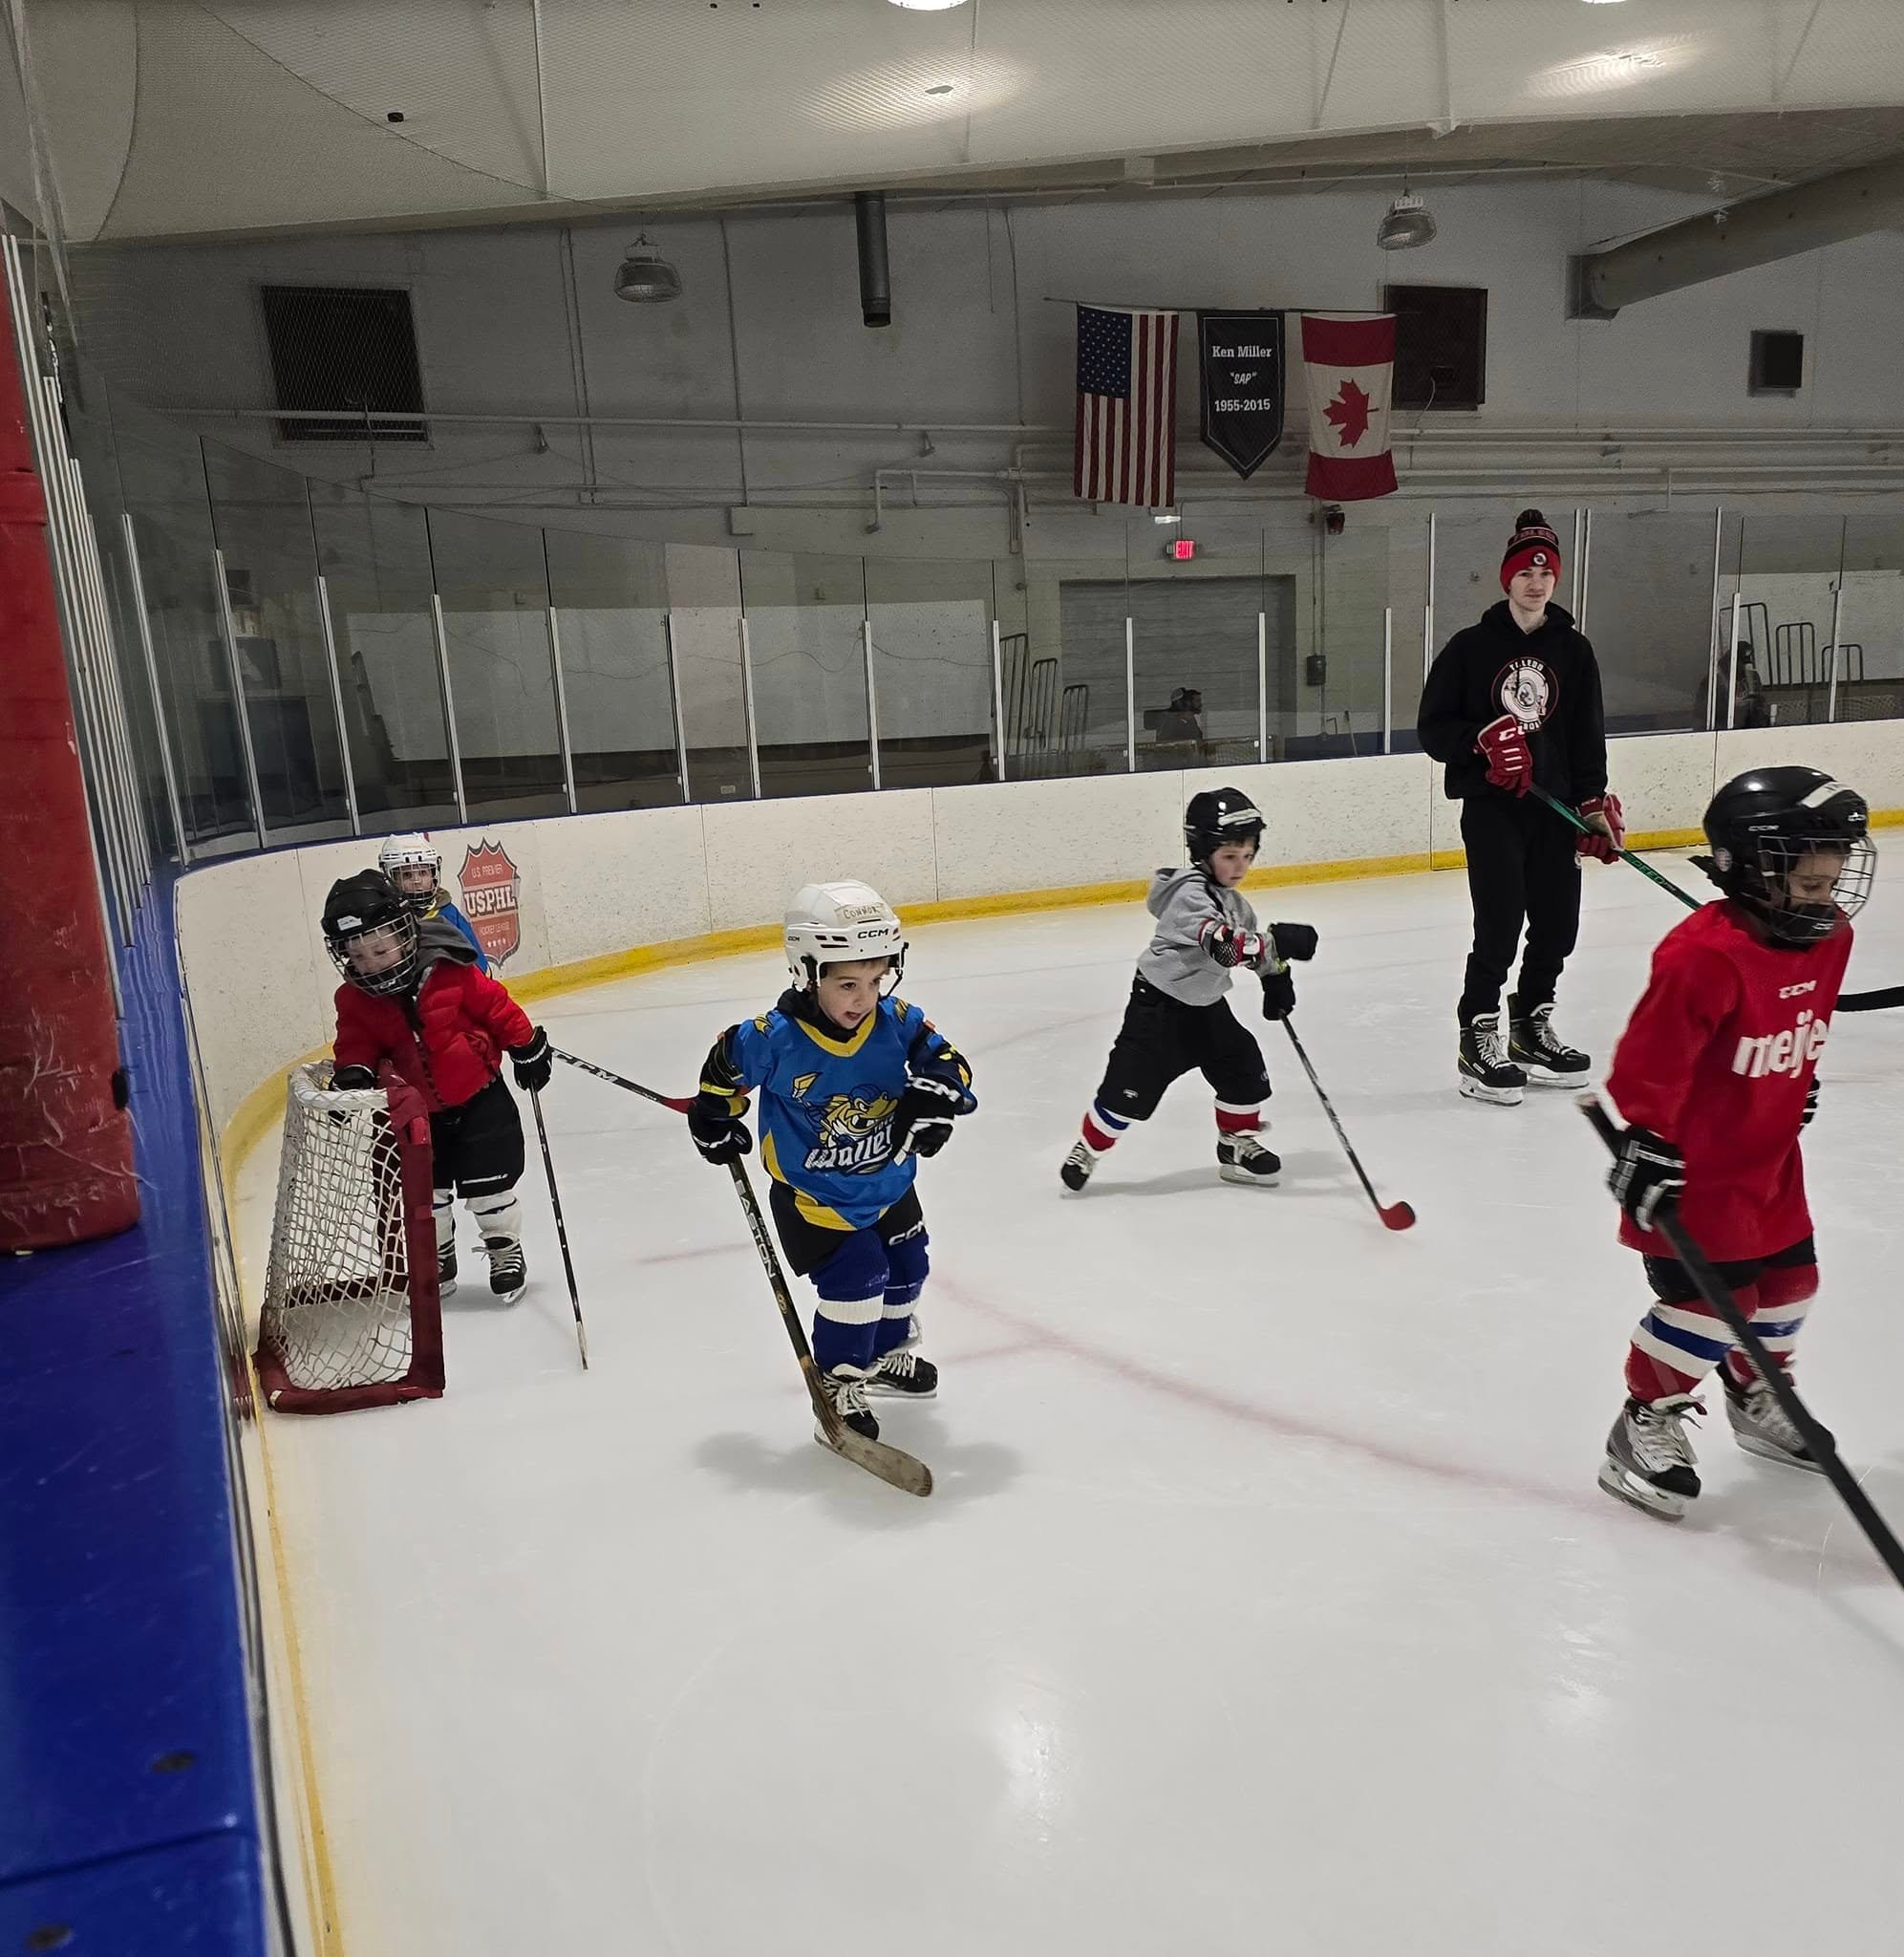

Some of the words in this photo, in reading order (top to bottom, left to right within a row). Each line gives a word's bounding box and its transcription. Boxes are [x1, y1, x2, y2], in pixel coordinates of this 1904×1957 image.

[1211, 345, 1234, 358] Ken
[1237, 345, 1273, 358] Miller
[1230, 371, 1257, 385] "SAP"
[1214, 398, 1271, 413] 1955-2015
[1175, 540, 1194, 559] EXIT
[464, 886, 516, 915] USPHL
[844, 905, 880, 919] CONNOR
[858, 928, 888, 939] CCM
[1731, 1009, 1829, 1079] meije
[735, 1179, 776, 1279] EASTON
